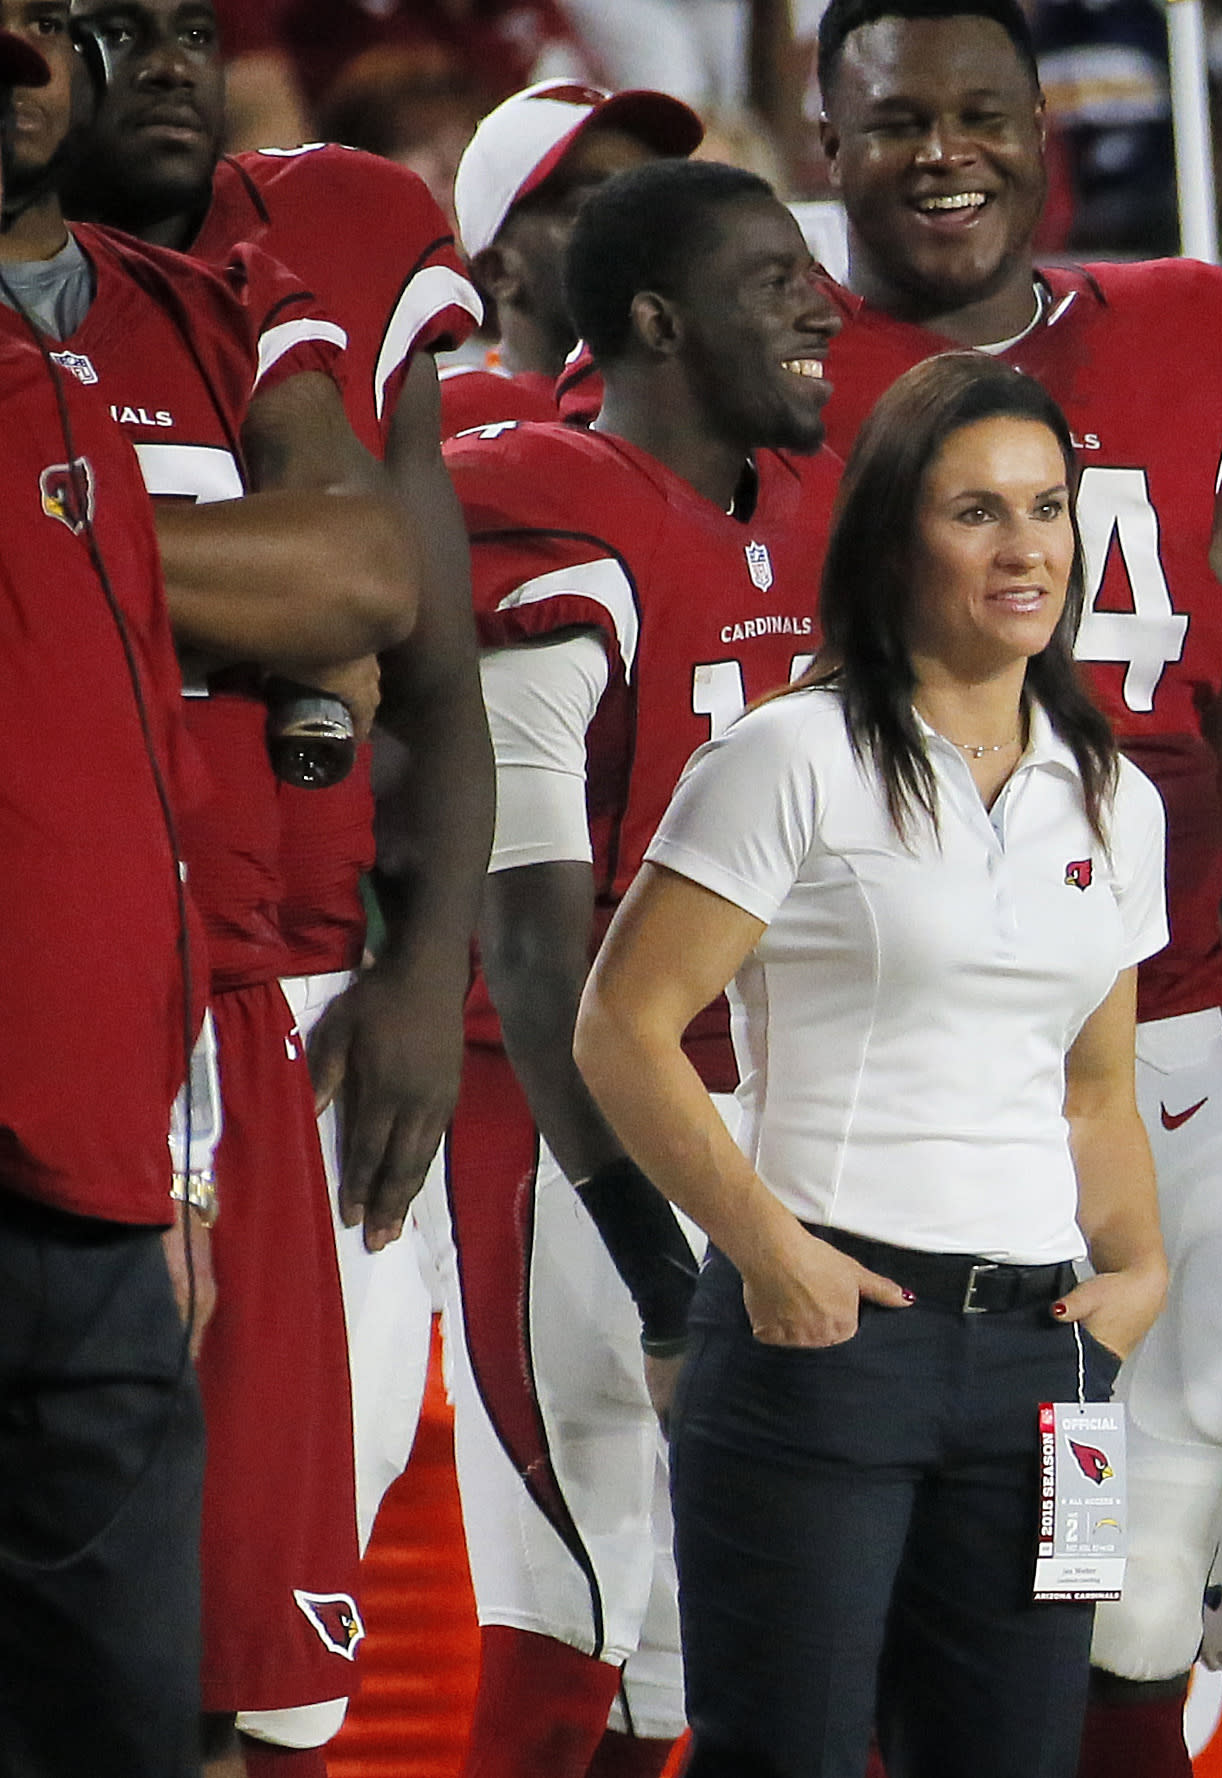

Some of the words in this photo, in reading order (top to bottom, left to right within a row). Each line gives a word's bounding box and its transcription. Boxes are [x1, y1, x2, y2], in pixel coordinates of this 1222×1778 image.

[721, 616, 812, 644] CARDINALS
[1062, 1418, 1118, 1430] OFFICIAL
[1042, 1432, 1055, 1497] SEASON
[1041, 1500, 1054, 1536] 2015
[1066, 1518, 1078, 1542] 2
[1034, 1592, 1073, 1600] ARIZONA
[1074, 1591, 1120, 1600] CARDINALS
